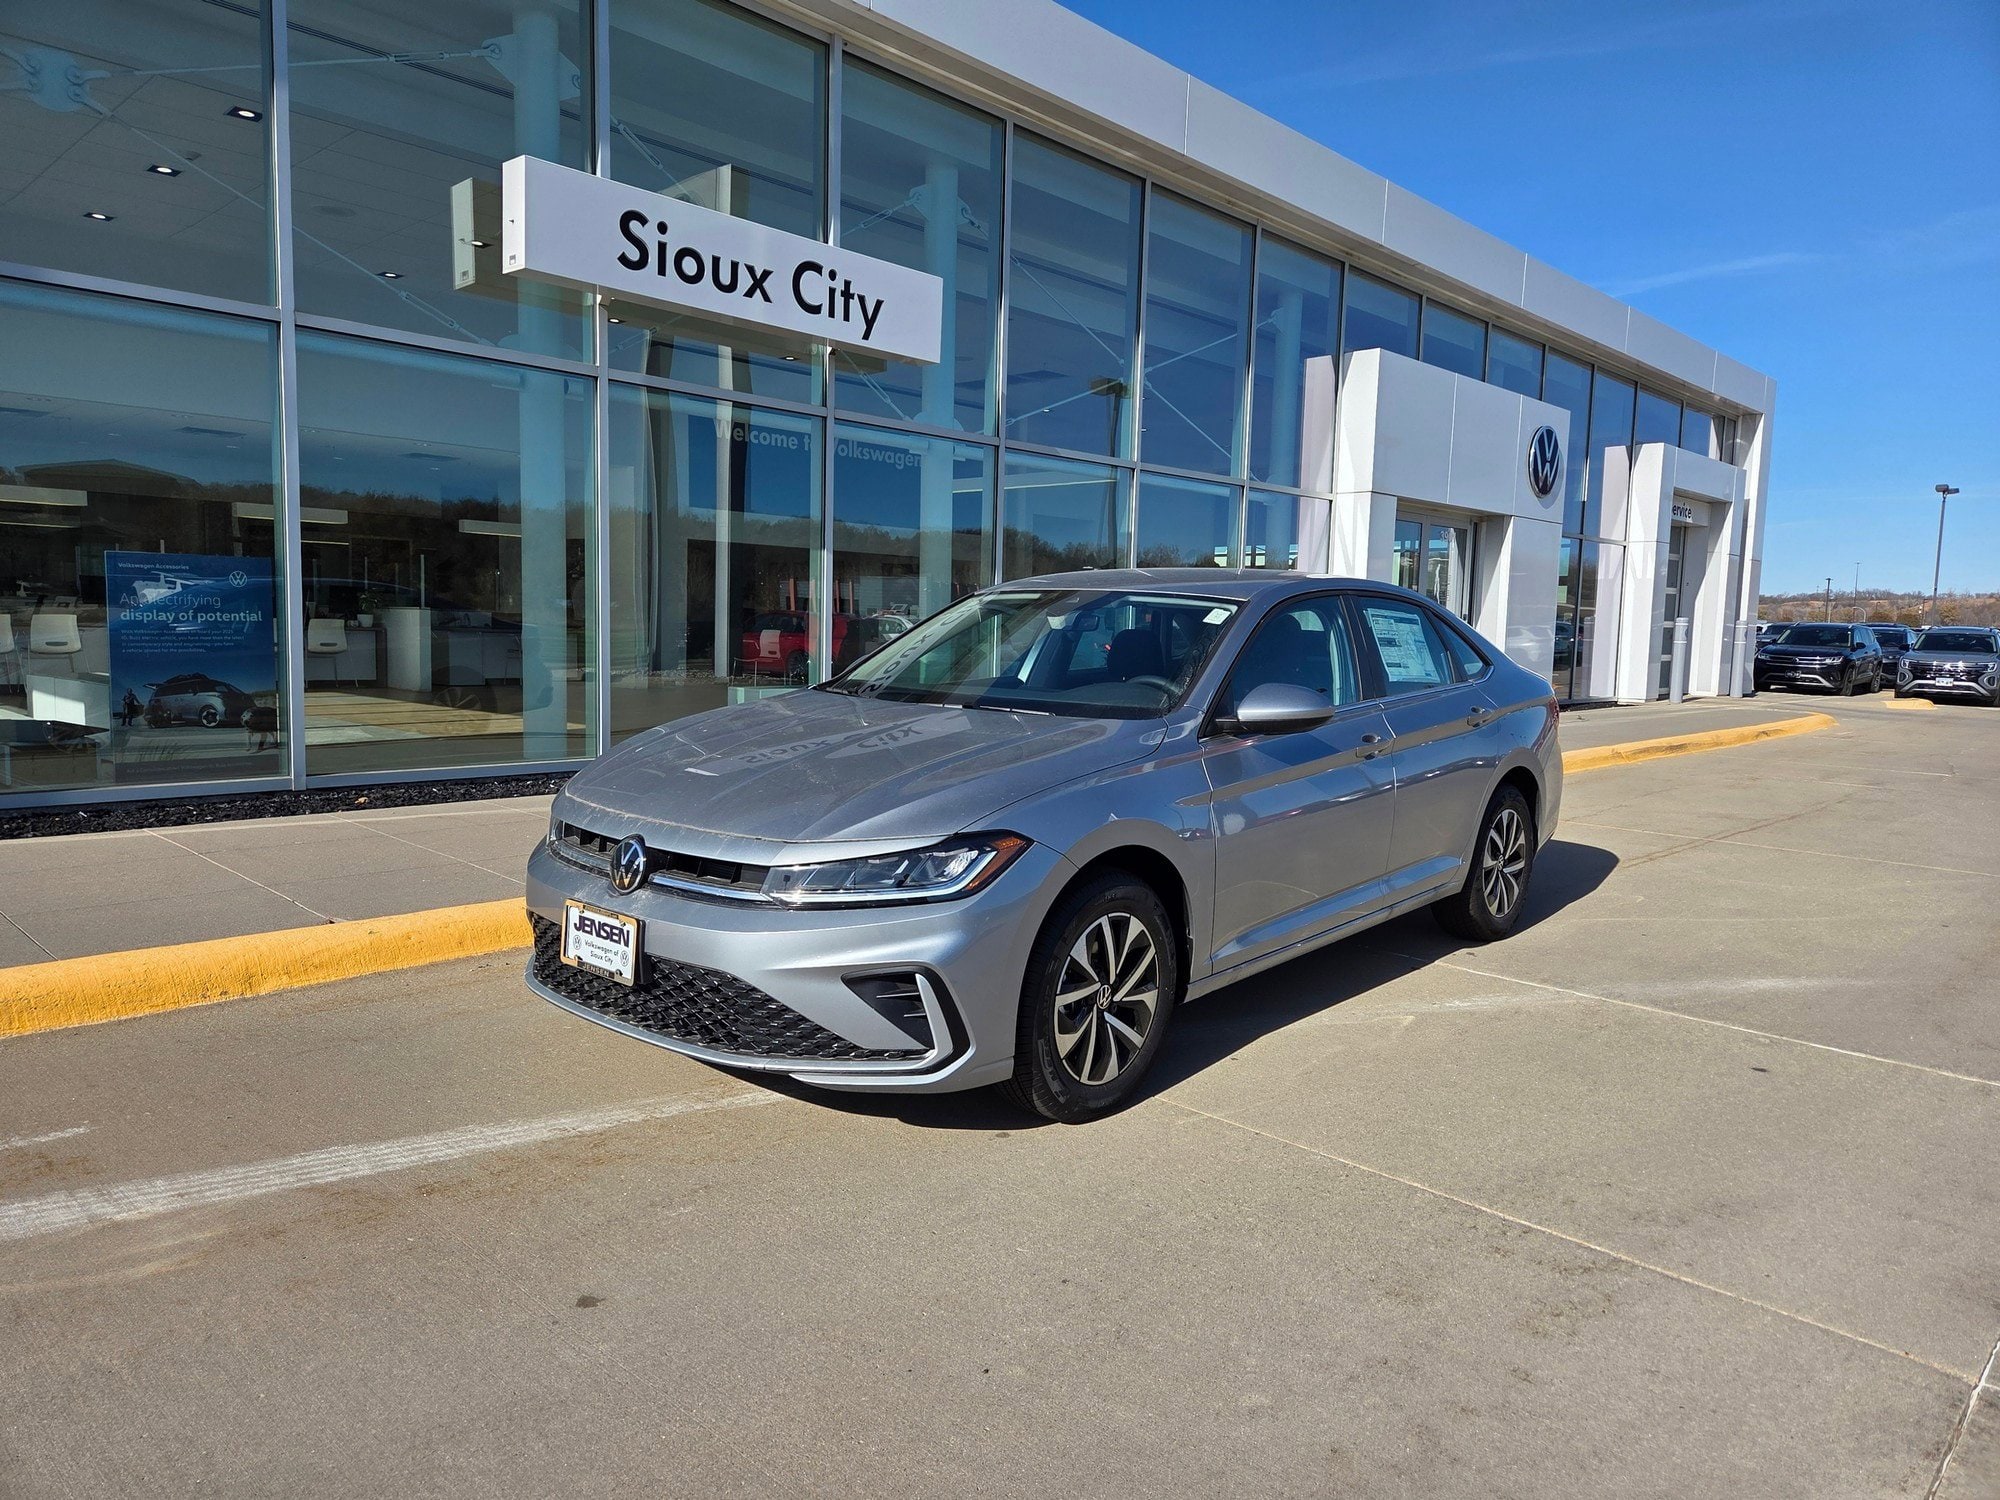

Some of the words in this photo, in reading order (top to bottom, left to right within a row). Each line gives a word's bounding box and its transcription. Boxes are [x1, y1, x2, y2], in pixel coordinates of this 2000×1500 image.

[617, 209, 773, 303] Sioux
[792, 260, 884, 340] City
[714, 417, 798, 450] Welcome
[1672, 502, 1692, 518] ervice
[145, 594, 221, 608] lectrifying
[120, 608, 175, 624] display
[178, 610, 194, 621] of
[198, 610, 262, 623] potential
[573, 915, 630, 948] JENSEN
[584, 939, 613, 955] Volkswagen
[613, 949, 619, 957] of
[590, 950, 604, 961] Sioux
[604, 955, 613, 966] City
[582, 962, 610, 978] JENSEN
